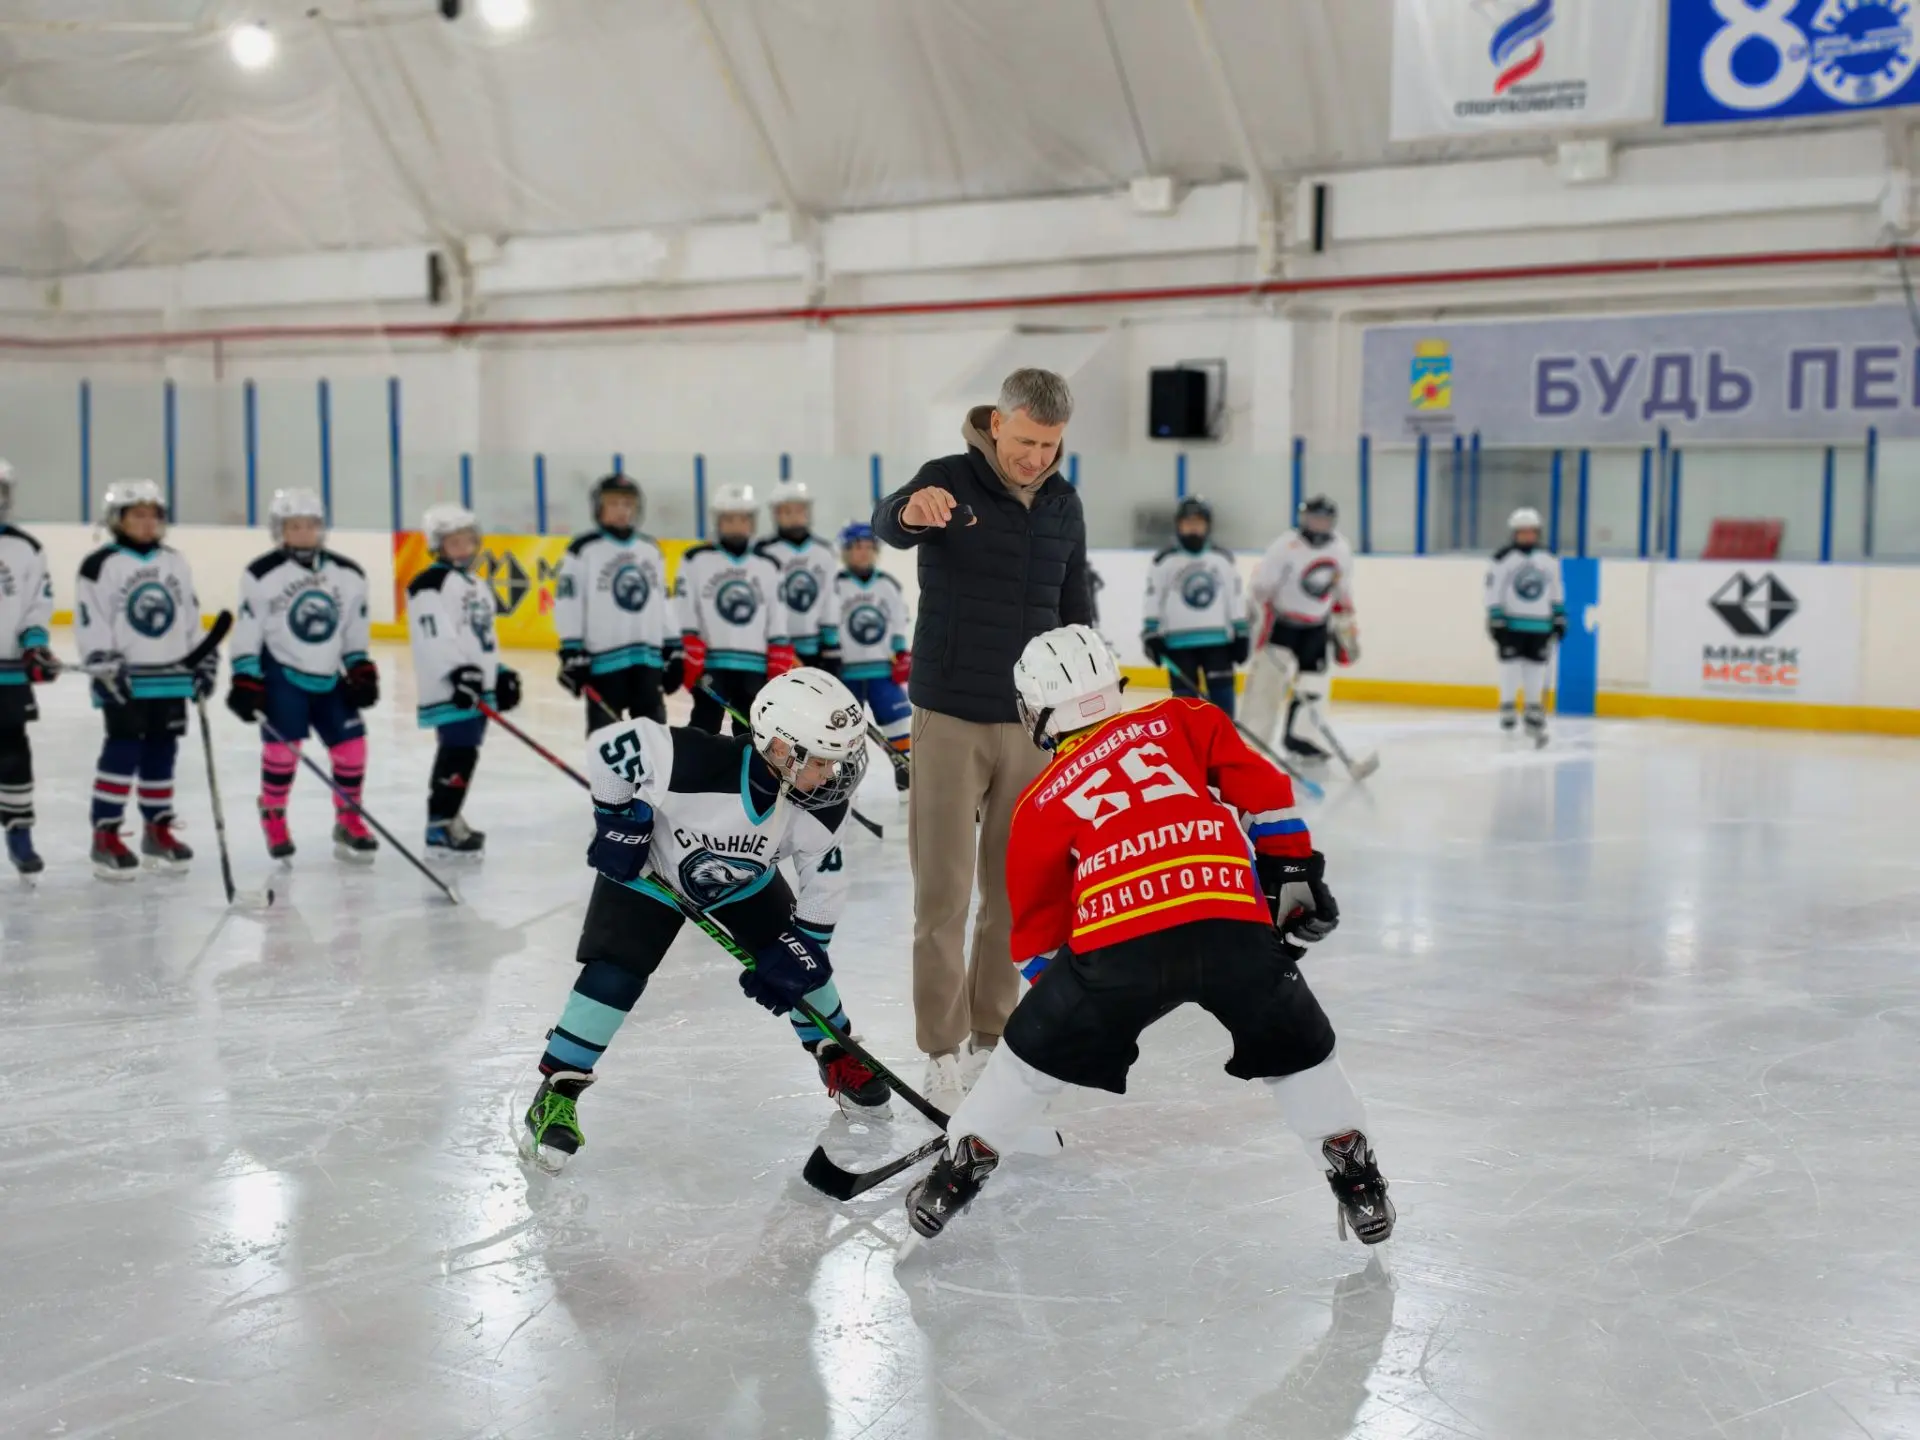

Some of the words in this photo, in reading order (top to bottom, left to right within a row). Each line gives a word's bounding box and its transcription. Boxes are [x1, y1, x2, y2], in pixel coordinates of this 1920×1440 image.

[1534, 352, 1754, 421] БУДЬ
[1787, 346, 1920, 411] ПЕ
[1703, 663, 1798, 686] MCSC
[775, 726, 799, 743] CCM
[1038, 719, 1168, 805] САДОВЕНКО
[1061, 742, 1199, 831] 65
[1077, 819, 1224, 882] МЕТАЛЛУРГ
[1077, 866, 1245, 924] МЕДНОГОРСК
